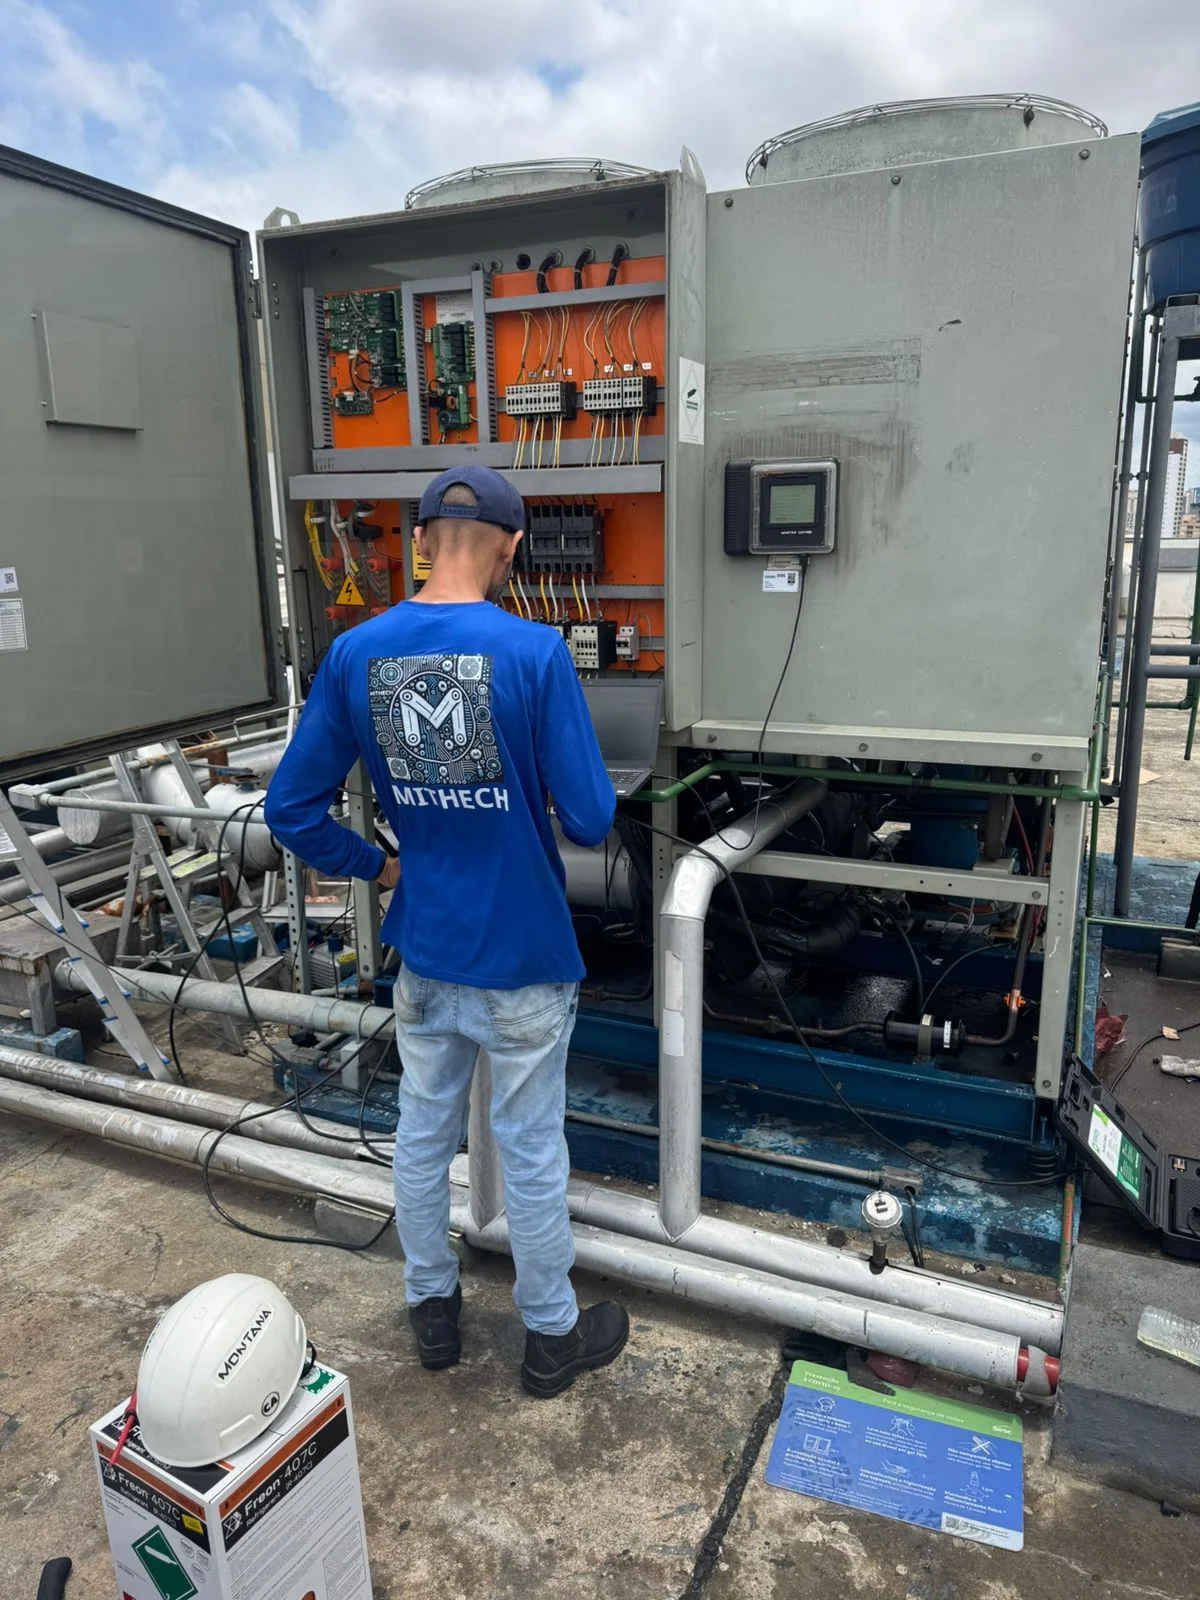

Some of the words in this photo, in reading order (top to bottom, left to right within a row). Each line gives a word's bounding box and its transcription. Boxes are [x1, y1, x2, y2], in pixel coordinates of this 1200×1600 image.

[392, 785, 509, 811] MITHECH
[218, 1309, 272, 1380] MONTANA
[264, 1396, 278, 1413] CA
[117, 1471, 148, 1500] Freon
[150, 1491, 180, 1522] 407C
[244, 1474, 280, 1517] Freon
[283, 1439, 317, 1480] 407C
[246, 1490, 280, 1528] Refrigerant
